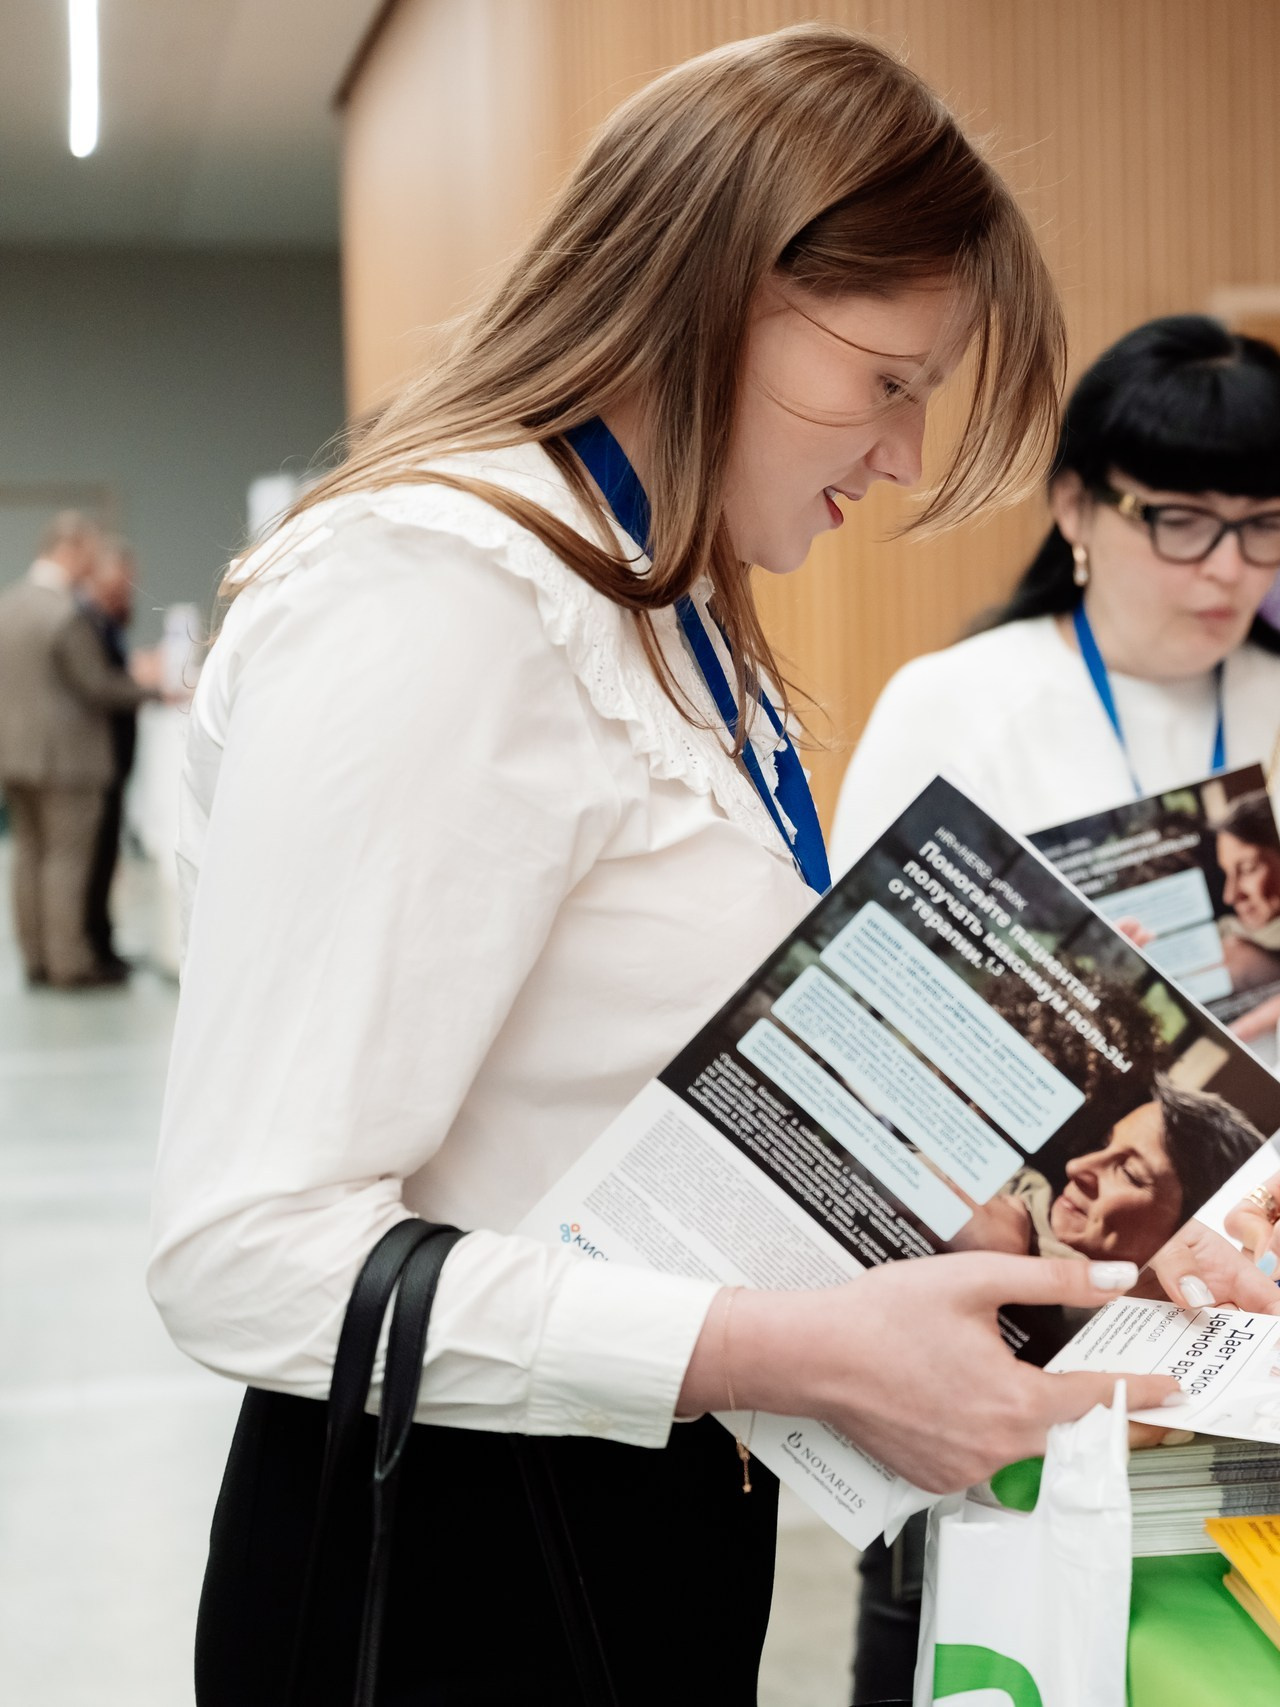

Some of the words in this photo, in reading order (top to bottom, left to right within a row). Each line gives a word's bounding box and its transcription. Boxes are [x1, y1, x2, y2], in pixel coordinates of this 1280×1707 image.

[887, 877, 916, 904] от
[918, 841, 1014, 928] Помогайте
[1007, 925, 1102, 1010] пациентам
[901, 860, 985, 935] получать
[981, 933, 1070, 1015] максимум
[1064, 1011, 1133, 1073] пользы
[1186, 1313, 1233, 1358] ценное
[1215, 1329, 1255, 1361] Дает
[1186, 1364, 1224, 1396] такое
[801, 1447, 865, 1509] NOVARTIS
